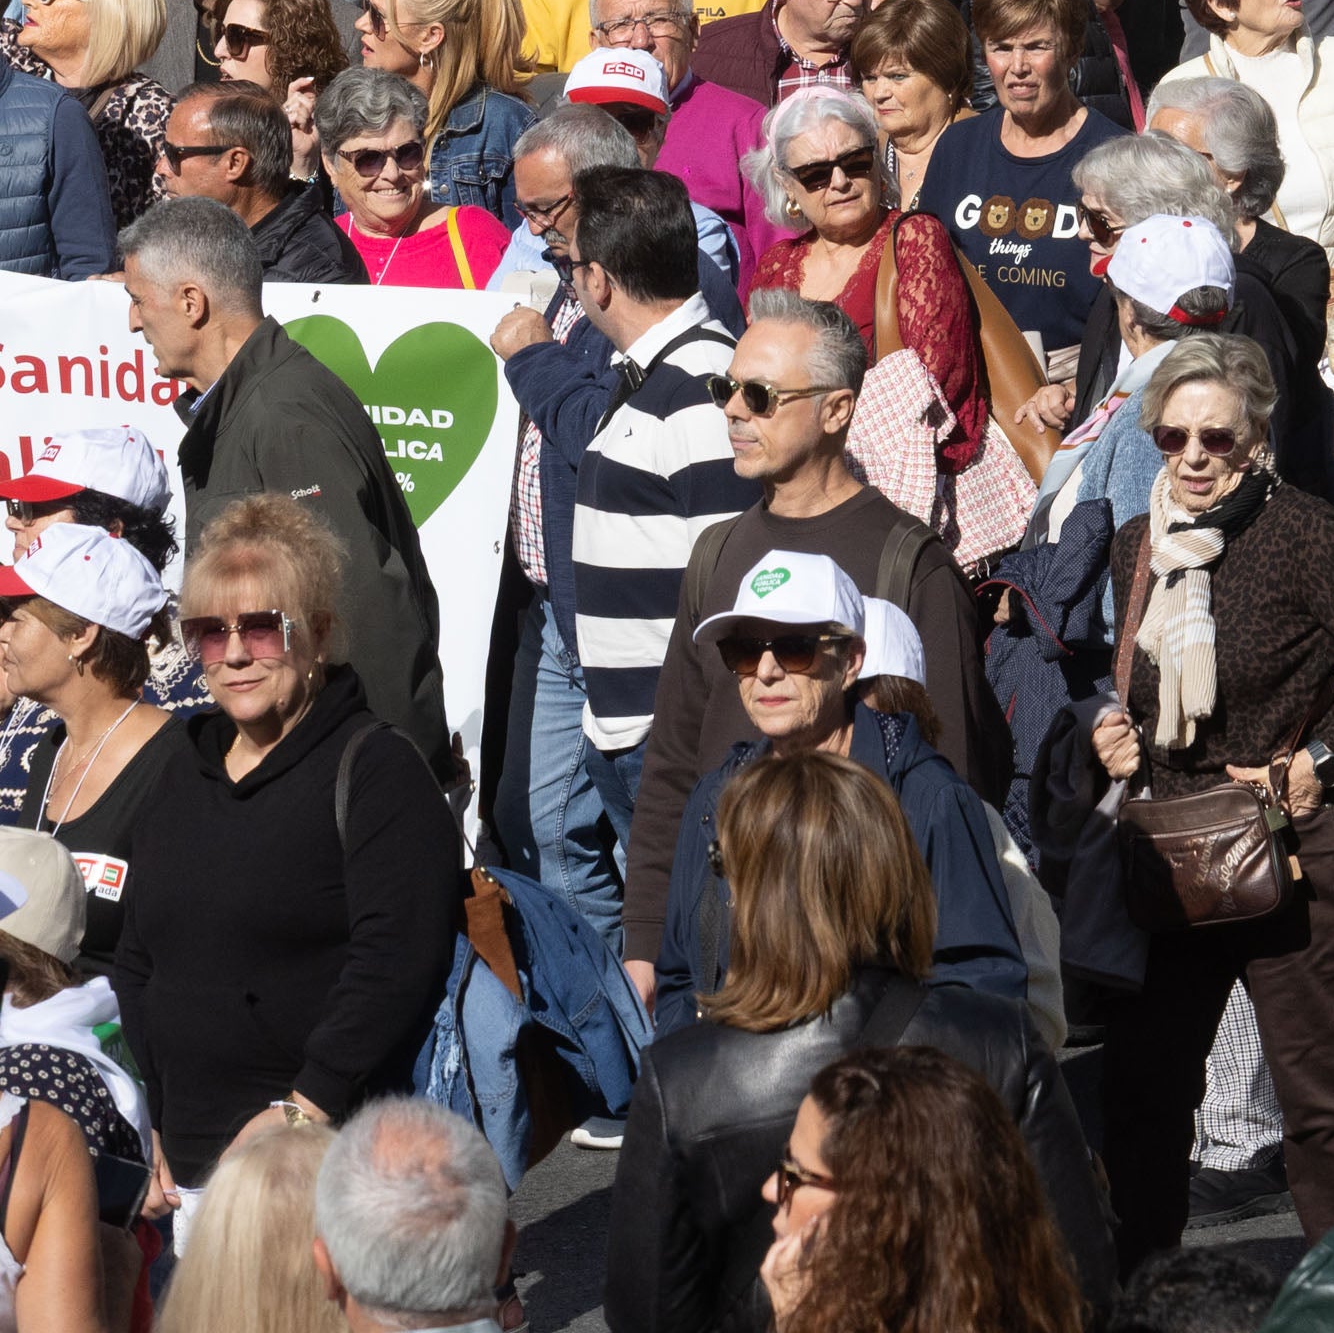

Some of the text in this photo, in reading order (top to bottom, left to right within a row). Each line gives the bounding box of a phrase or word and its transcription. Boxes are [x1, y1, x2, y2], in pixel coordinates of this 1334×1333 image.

[696, 7, 726, 17] FILA
[605, 63, 644, 78] CCOO
[989, 238, 1032, 265] things
[998, 266, 1066, 287] COMING
[0, 343, 192, 406] anida
[291, 484, 321, 500] Schott
